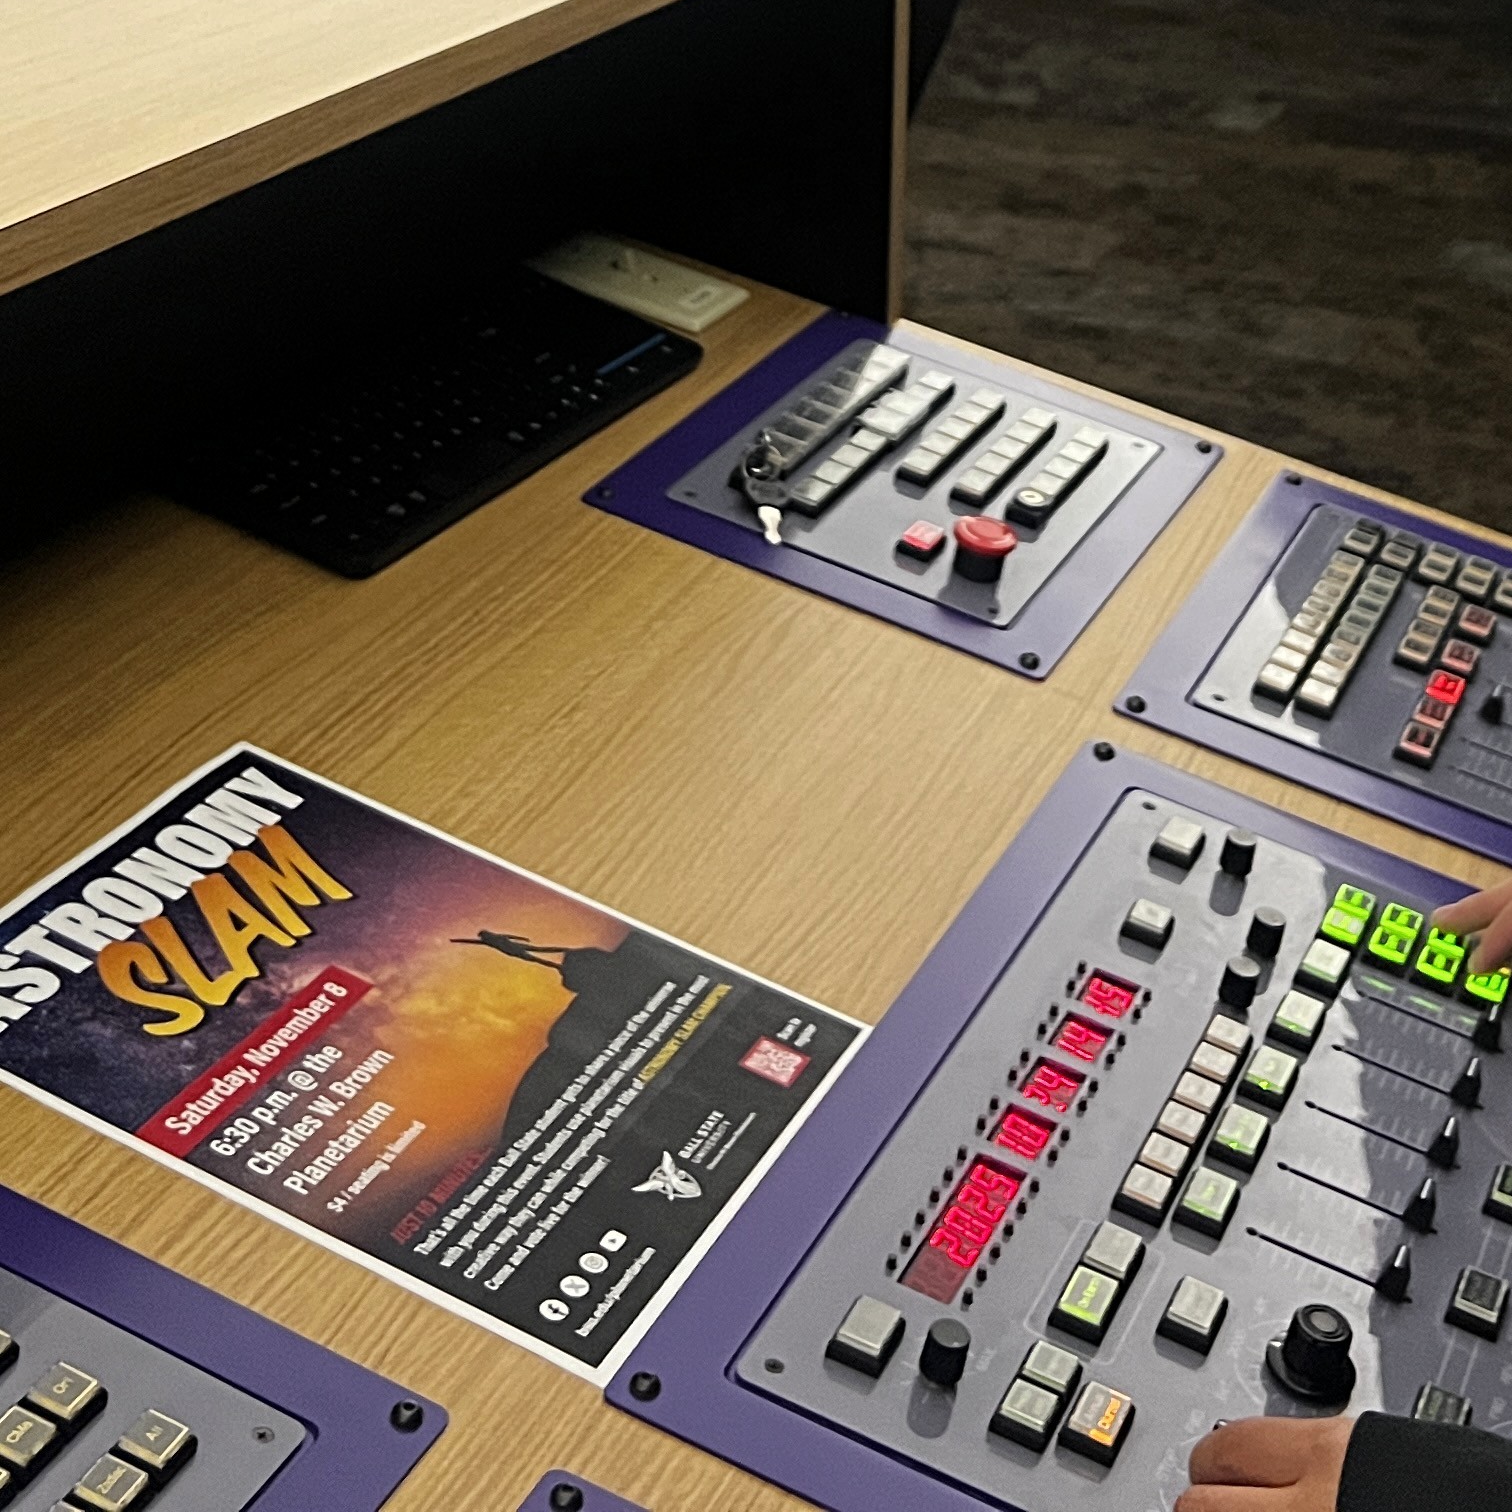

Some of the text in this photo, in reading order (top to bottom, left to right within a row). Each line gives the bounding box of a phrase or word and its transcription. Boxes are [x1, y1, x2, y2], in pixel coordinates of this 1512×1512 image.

[0, 766, 304, 1034] STRONOMY
[97, 824, 353, 1036] SLAM
[164, 982, 347, 1134] Saturday, November 8
[209, 1045, 342, 1155] 6:30 p.m. @ the
[247, 1050, 393, 1174] Charles W. Brown
[283, 1101, 394, 1194] Planetarium
[326, 1196, 348, 1212] $4
[347, 1160, 390, 1194] seating
[928, 1163, 1021, 1269] 2025
[996, 1112, 1051, 1161] 10
[1057, 1020, 1107, 1063] 14
